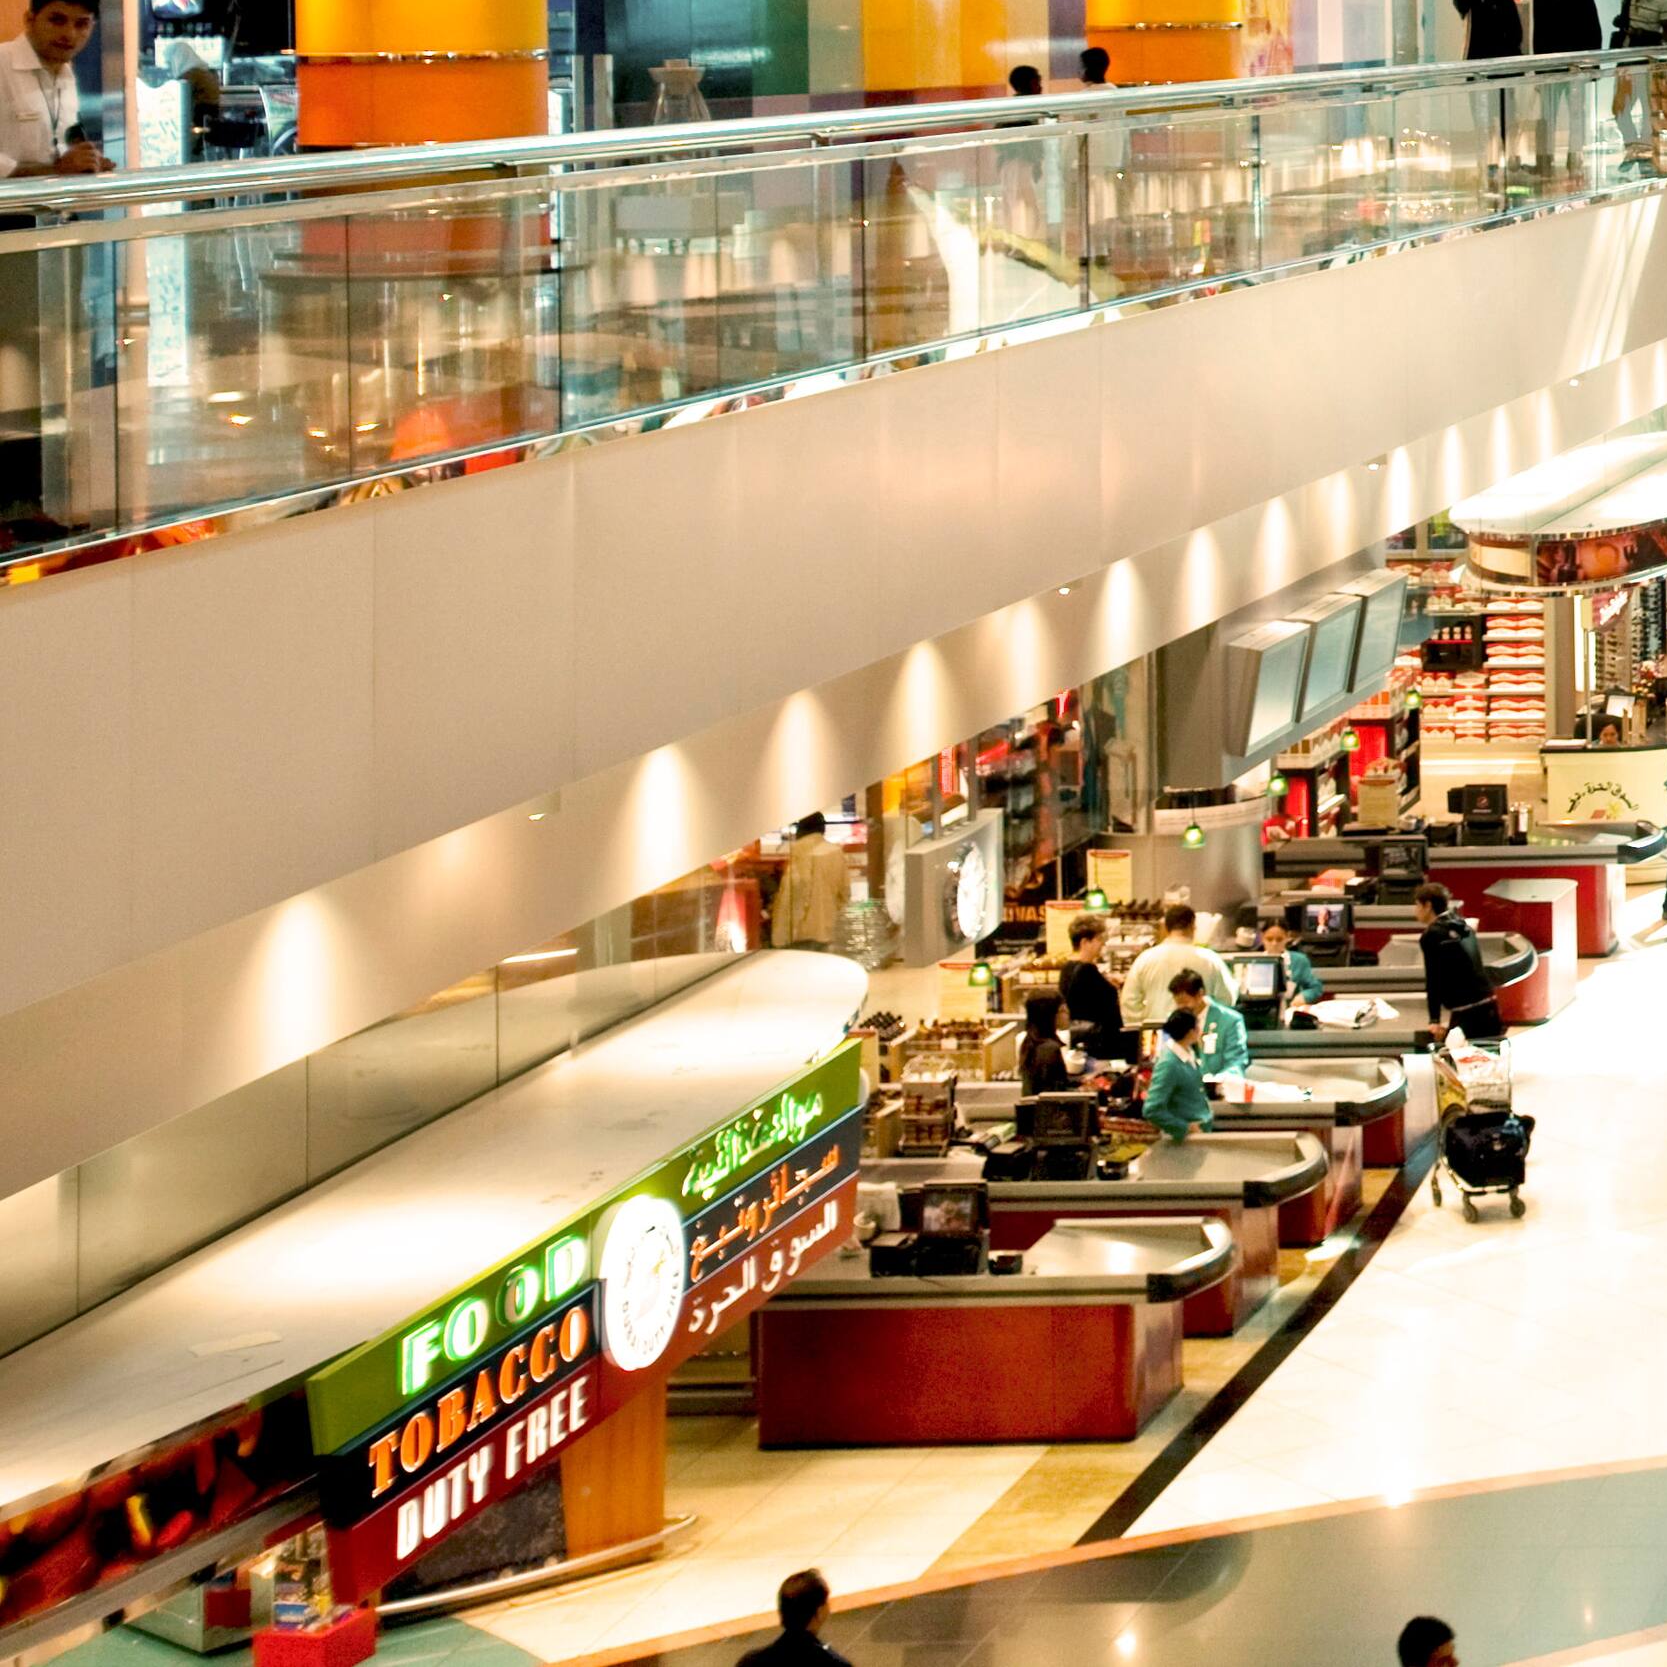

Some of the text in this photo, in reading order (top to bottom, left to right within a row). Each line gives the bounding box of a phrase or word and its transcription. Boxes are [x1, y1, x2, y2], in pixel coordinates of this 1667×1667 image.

[401, 1234, 588, 1397] FOOD
[688, 1254, 756, 1334] الحرة
[761, 1199, 838, 1292] السوق
[368, 1305, 589, 1499] TOBACCO
[396, 1376, 590, 1561] DUTY FREE
